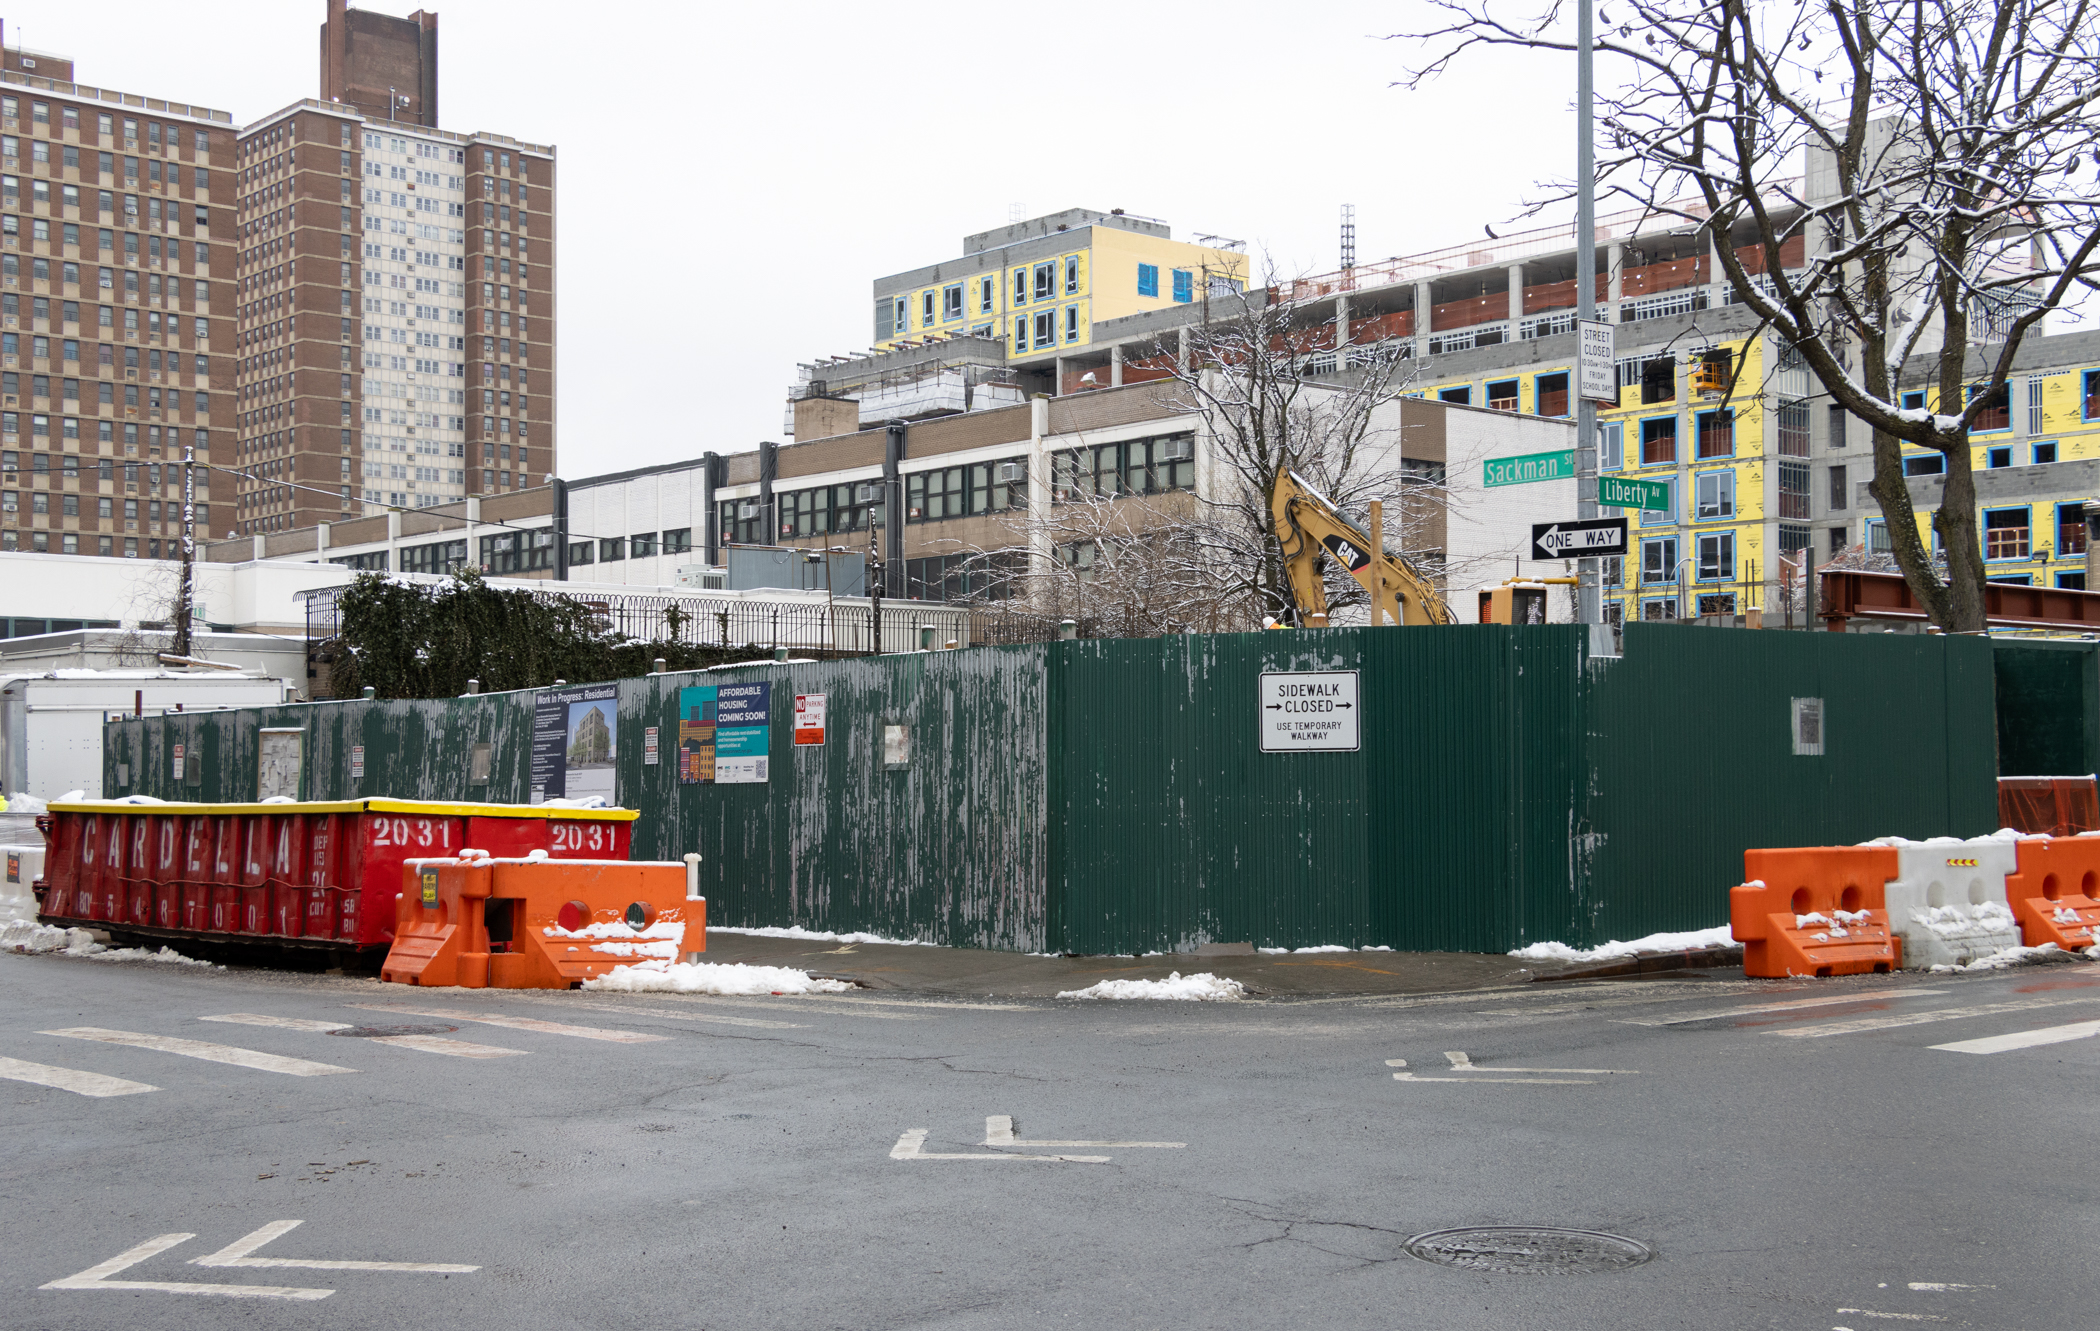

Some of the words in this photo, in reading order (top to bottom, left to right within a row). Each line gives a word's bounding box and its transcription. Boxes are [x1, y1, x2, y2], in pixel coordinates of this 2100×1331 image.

[1584, 329, 1610, 343] STREET
[1584, 344, 1611, 358] CLOSED
[1589, 371, 1607, 380] FRIDAY
[1582, 381, 1601, 391] SCHOOL
[1602, 384, 1613, 393] DAYS
[1487, 458, 1558, 484] Sackman
[1564, 453, 1573, 465] St
[1605, 480, 1648, 508] Liberty
[1651, 486, 1660, 498] Av
[1546, 532, 1573, 549] ONE
[1585, 529, 1615, 546] WAY
[1337, 541, 1359, 568] CAT
[537, 694, 551, 705] Work
[551, 693, 557, 703] In
[557, 692, 584, 704] Progress:
[584, 687, 615, 700] Residential
[719, 686, 761, 697] AFFORDABLE
[1278, 683, 1340, 697] SIDEWALK
[718, 700, 748, 710] HOUSING
[796, 699, 805, 710] NO
[806, 700, 823, 708] PARKING
[1285, 699, 1334, 713] CLOSED
[718, 713, 744, 722] COMING
[744, 711, 766, 721] SOON!
[799, 713, 821, 721] ANYTIME
[1276, 722, 1292, 731] USE
[1295, 721, 1342, 731] TEMPORARY
[1291, 732, 1328, 741] WALKWAY
[373, 817, 450, 848] 2031
[552, 824, 616, 851] 2031
[83, 817, 289, 875] CARDELLA
